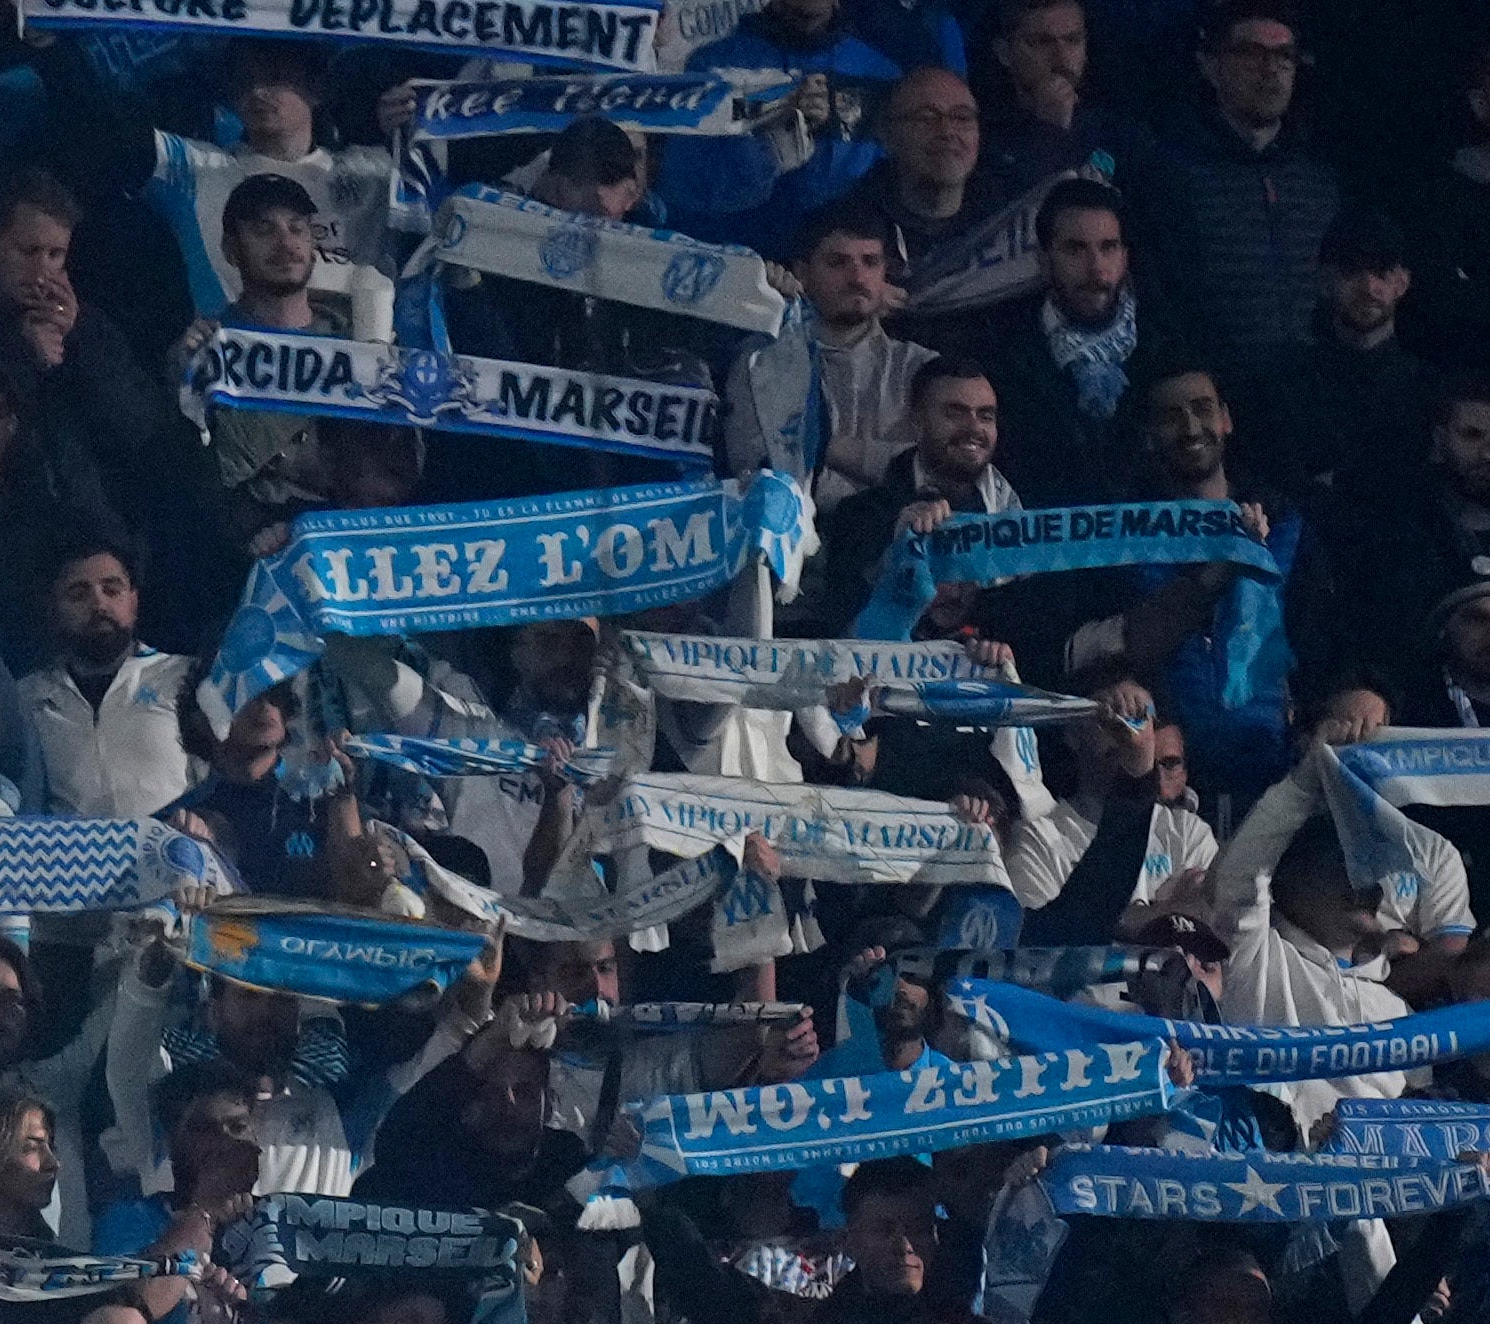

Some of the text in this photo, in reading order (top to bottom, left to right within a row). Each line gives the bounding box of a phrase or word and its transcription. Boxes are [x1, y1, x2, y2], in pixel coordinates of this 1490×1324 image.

[1070, 508, 1115, 540] DE
[538, 511, 718, 588] L'OM
[1256, 1042, 1297, 1075] DU
[681, 1073, 872, 1142] L'OM
[1071, 1172, 1223, 1216] STARS
